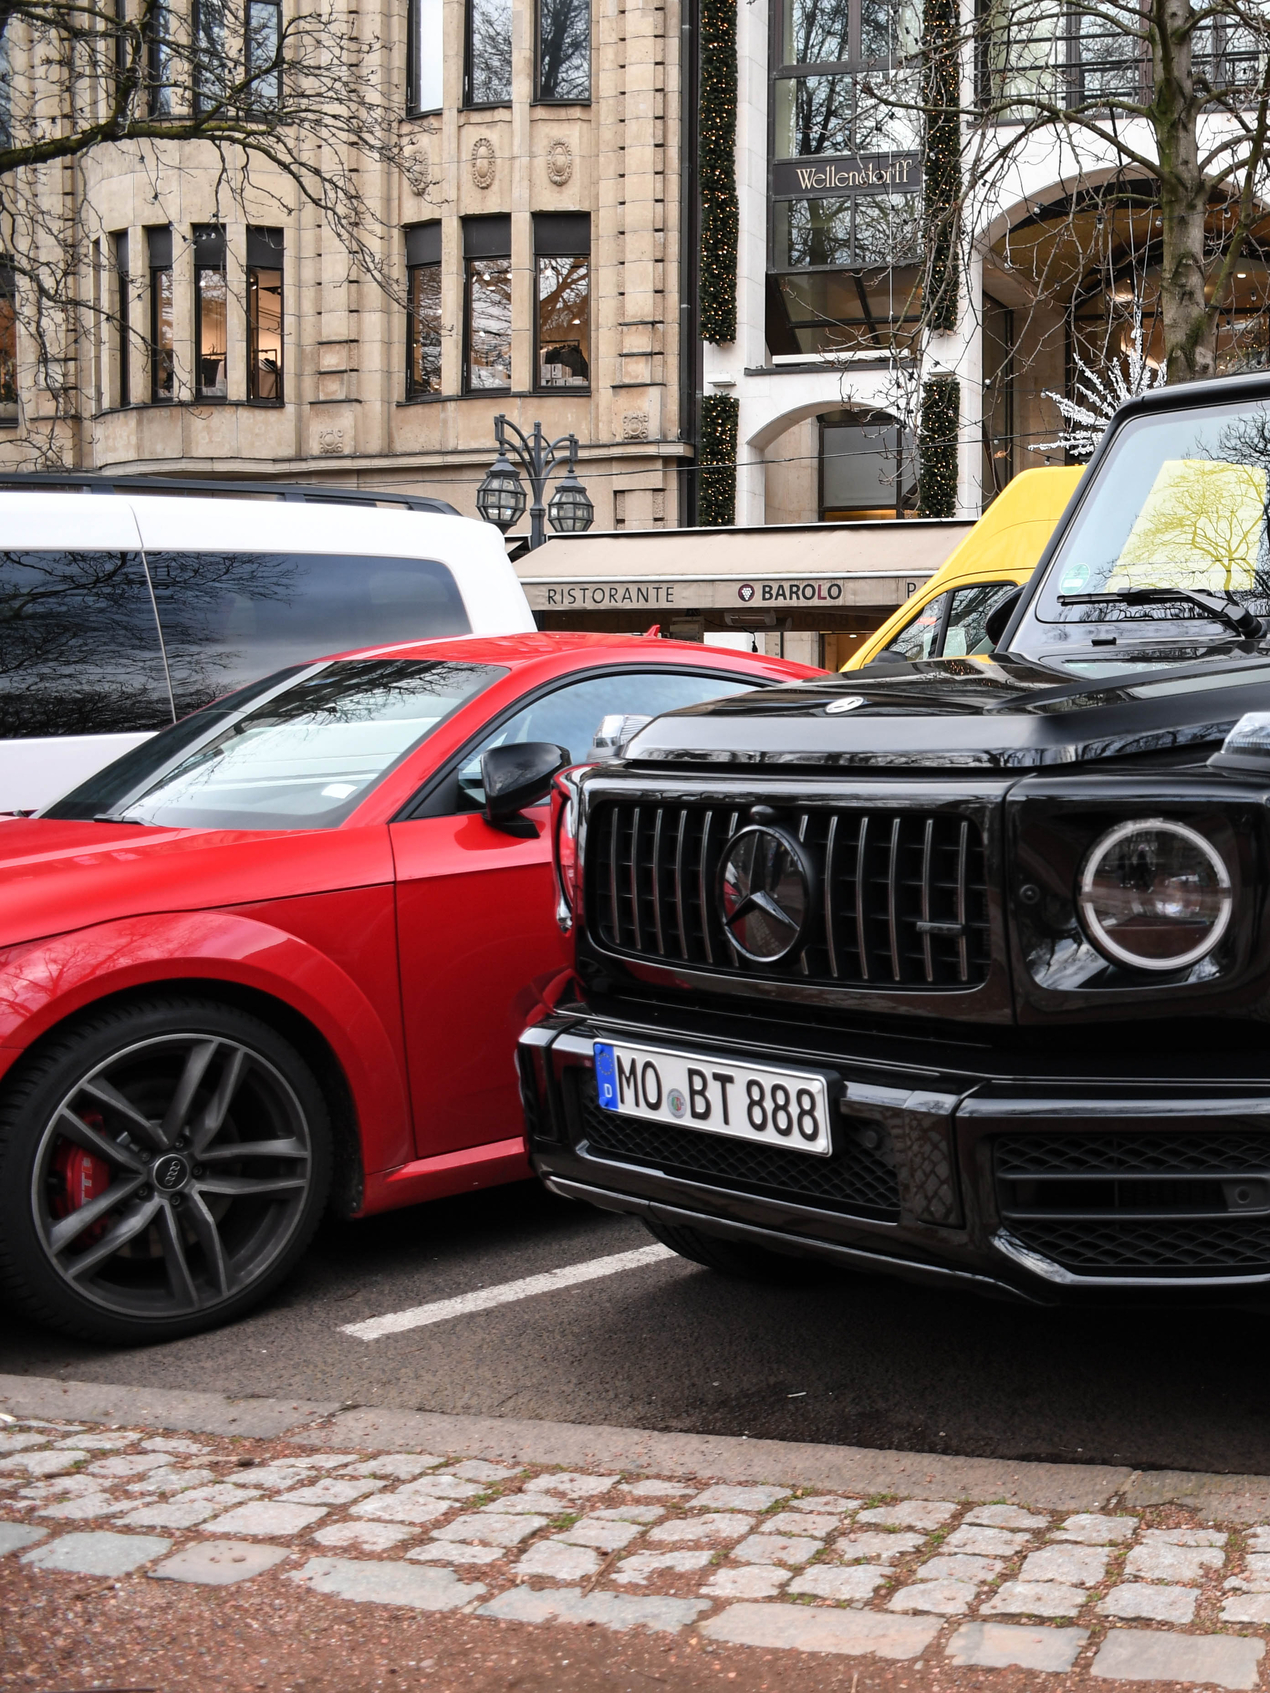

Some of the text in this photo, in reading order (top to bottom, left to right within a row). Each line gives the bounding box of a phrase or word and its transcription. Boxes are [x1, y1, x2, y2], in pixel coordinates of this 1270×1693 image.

[796, 160, 913, 190] Wellendorff
[547, 586, 675, 605] RISTORANTE
[761, 583, 842, 601] BAROLO
[604, 1053, 820, 1142] D MO BT 888
